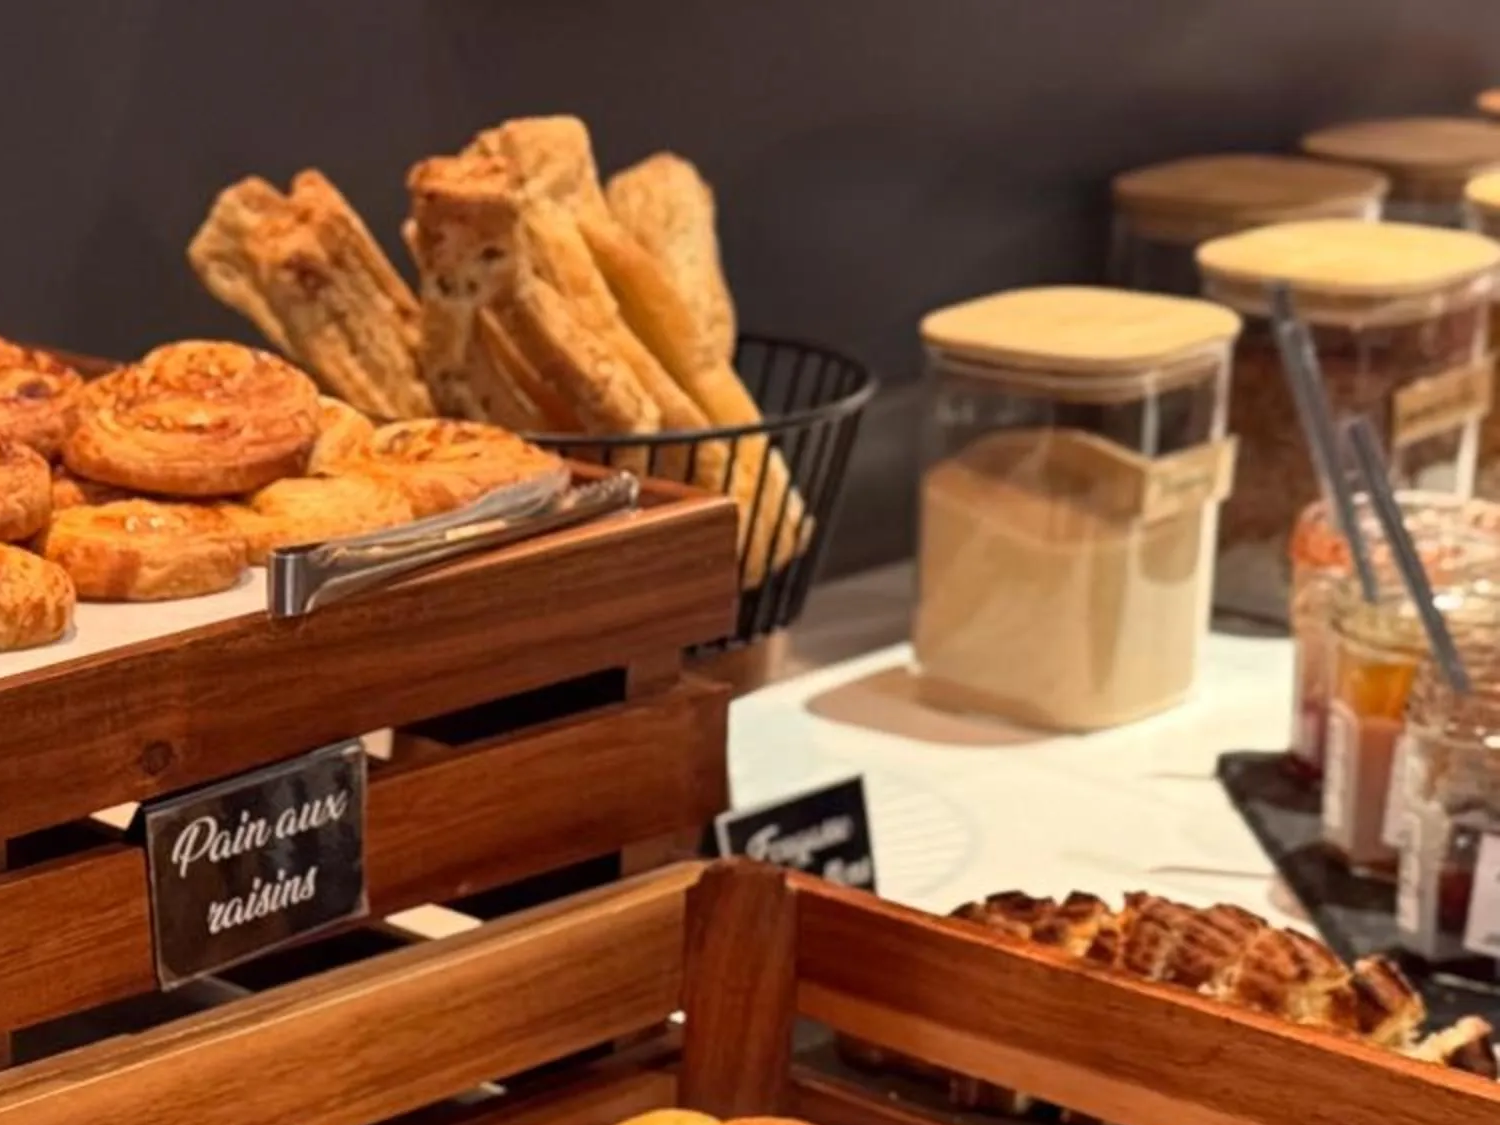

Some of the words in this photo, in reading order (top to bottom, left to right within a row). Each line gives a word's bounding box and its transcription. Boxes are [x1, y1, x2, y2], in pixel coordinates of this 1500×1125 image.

[171, 810, 271, 878] Pain
[275, 790, 348, 839] aux
[207, 866, 318, 934] raisins
